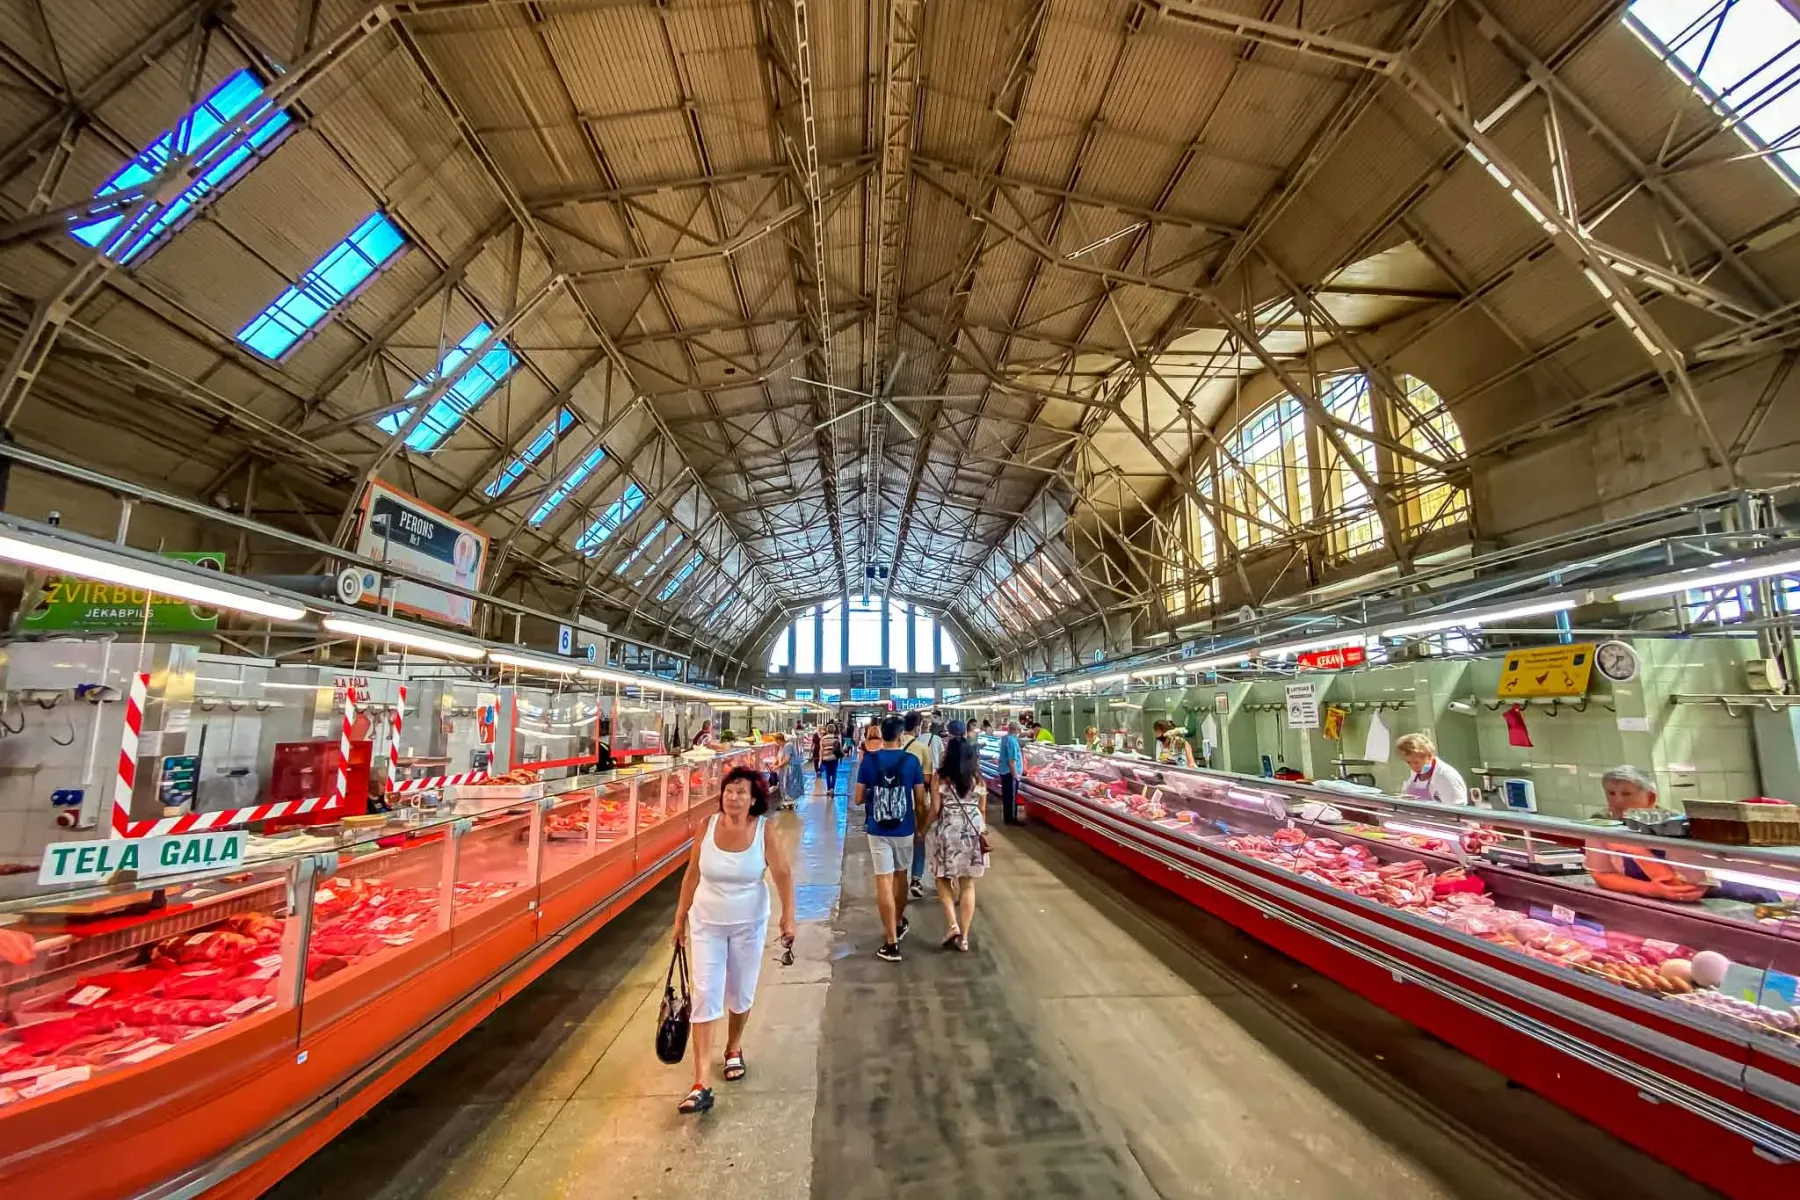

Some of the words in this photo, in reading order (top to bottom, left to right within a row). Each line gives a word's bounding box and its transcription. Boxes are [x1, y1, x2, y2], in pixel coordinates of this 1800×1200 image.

[399, 510, 434, 539] PERONS
[562, 630, 569, 649] 6
[51, 843, 140, 877] TEĻA
[160, 836, 238, 866] GAĻA
